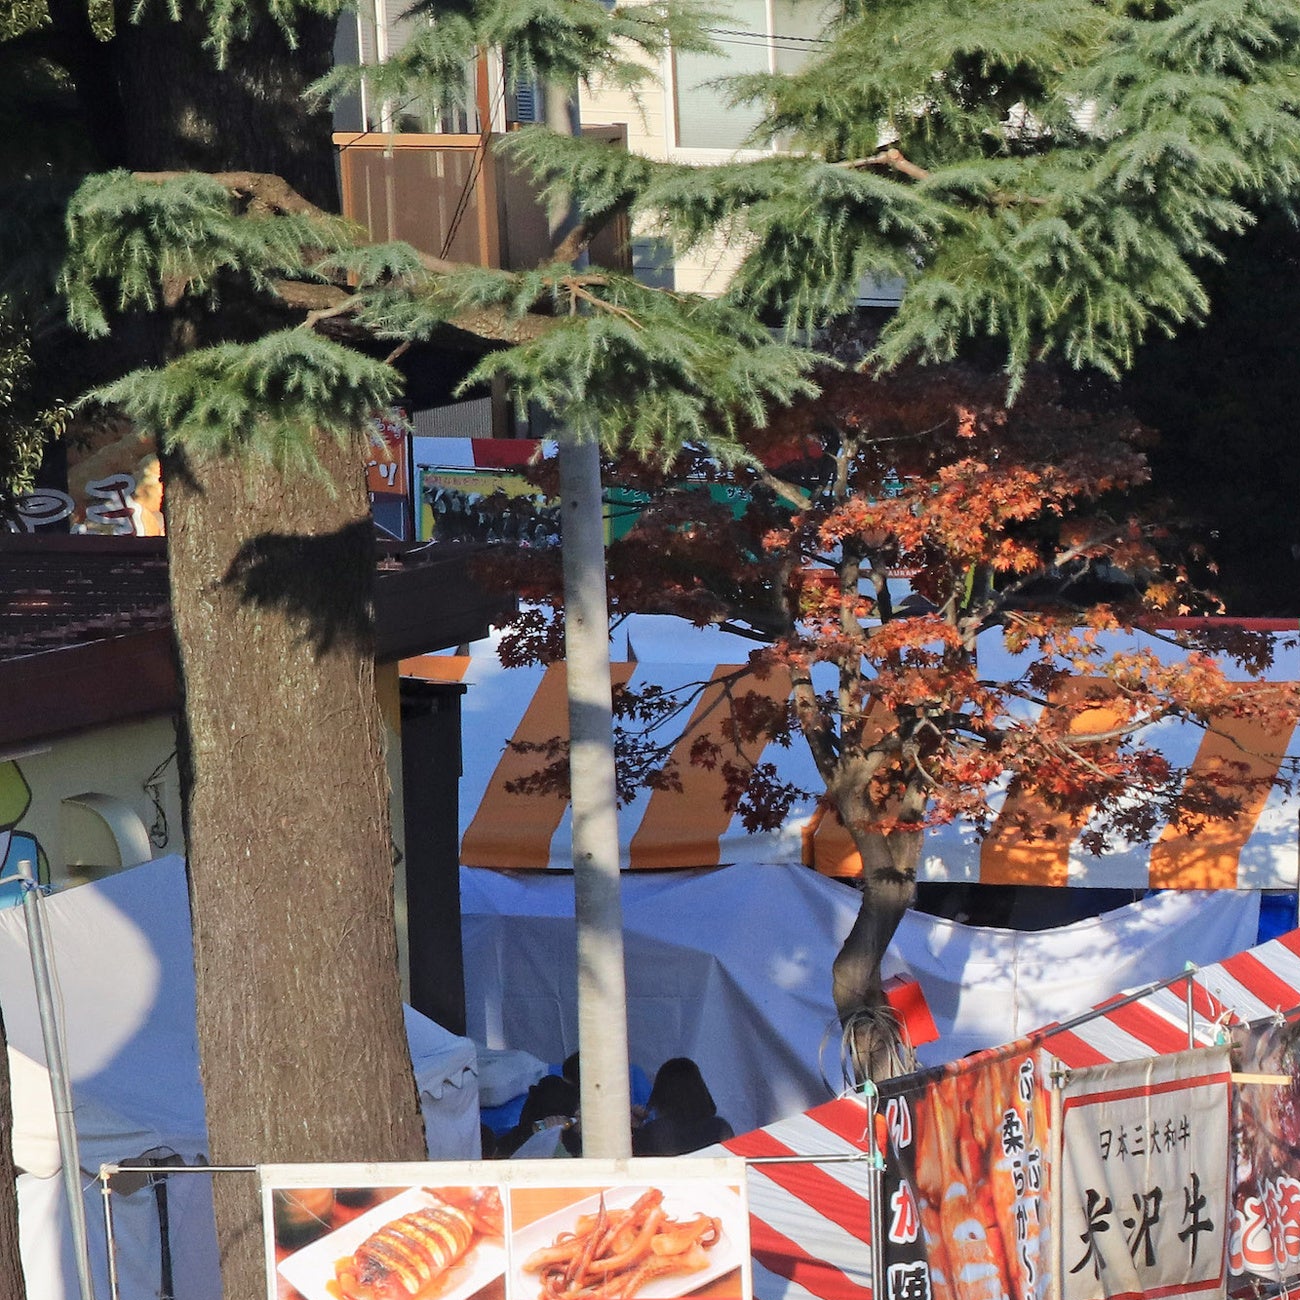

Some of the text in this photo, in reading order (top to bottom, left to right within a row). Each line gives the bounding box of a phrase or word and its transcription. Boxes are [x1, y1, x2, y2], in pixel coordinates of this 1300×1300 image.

[1099, 1115, 1192, 1162] 日本三大和牛
